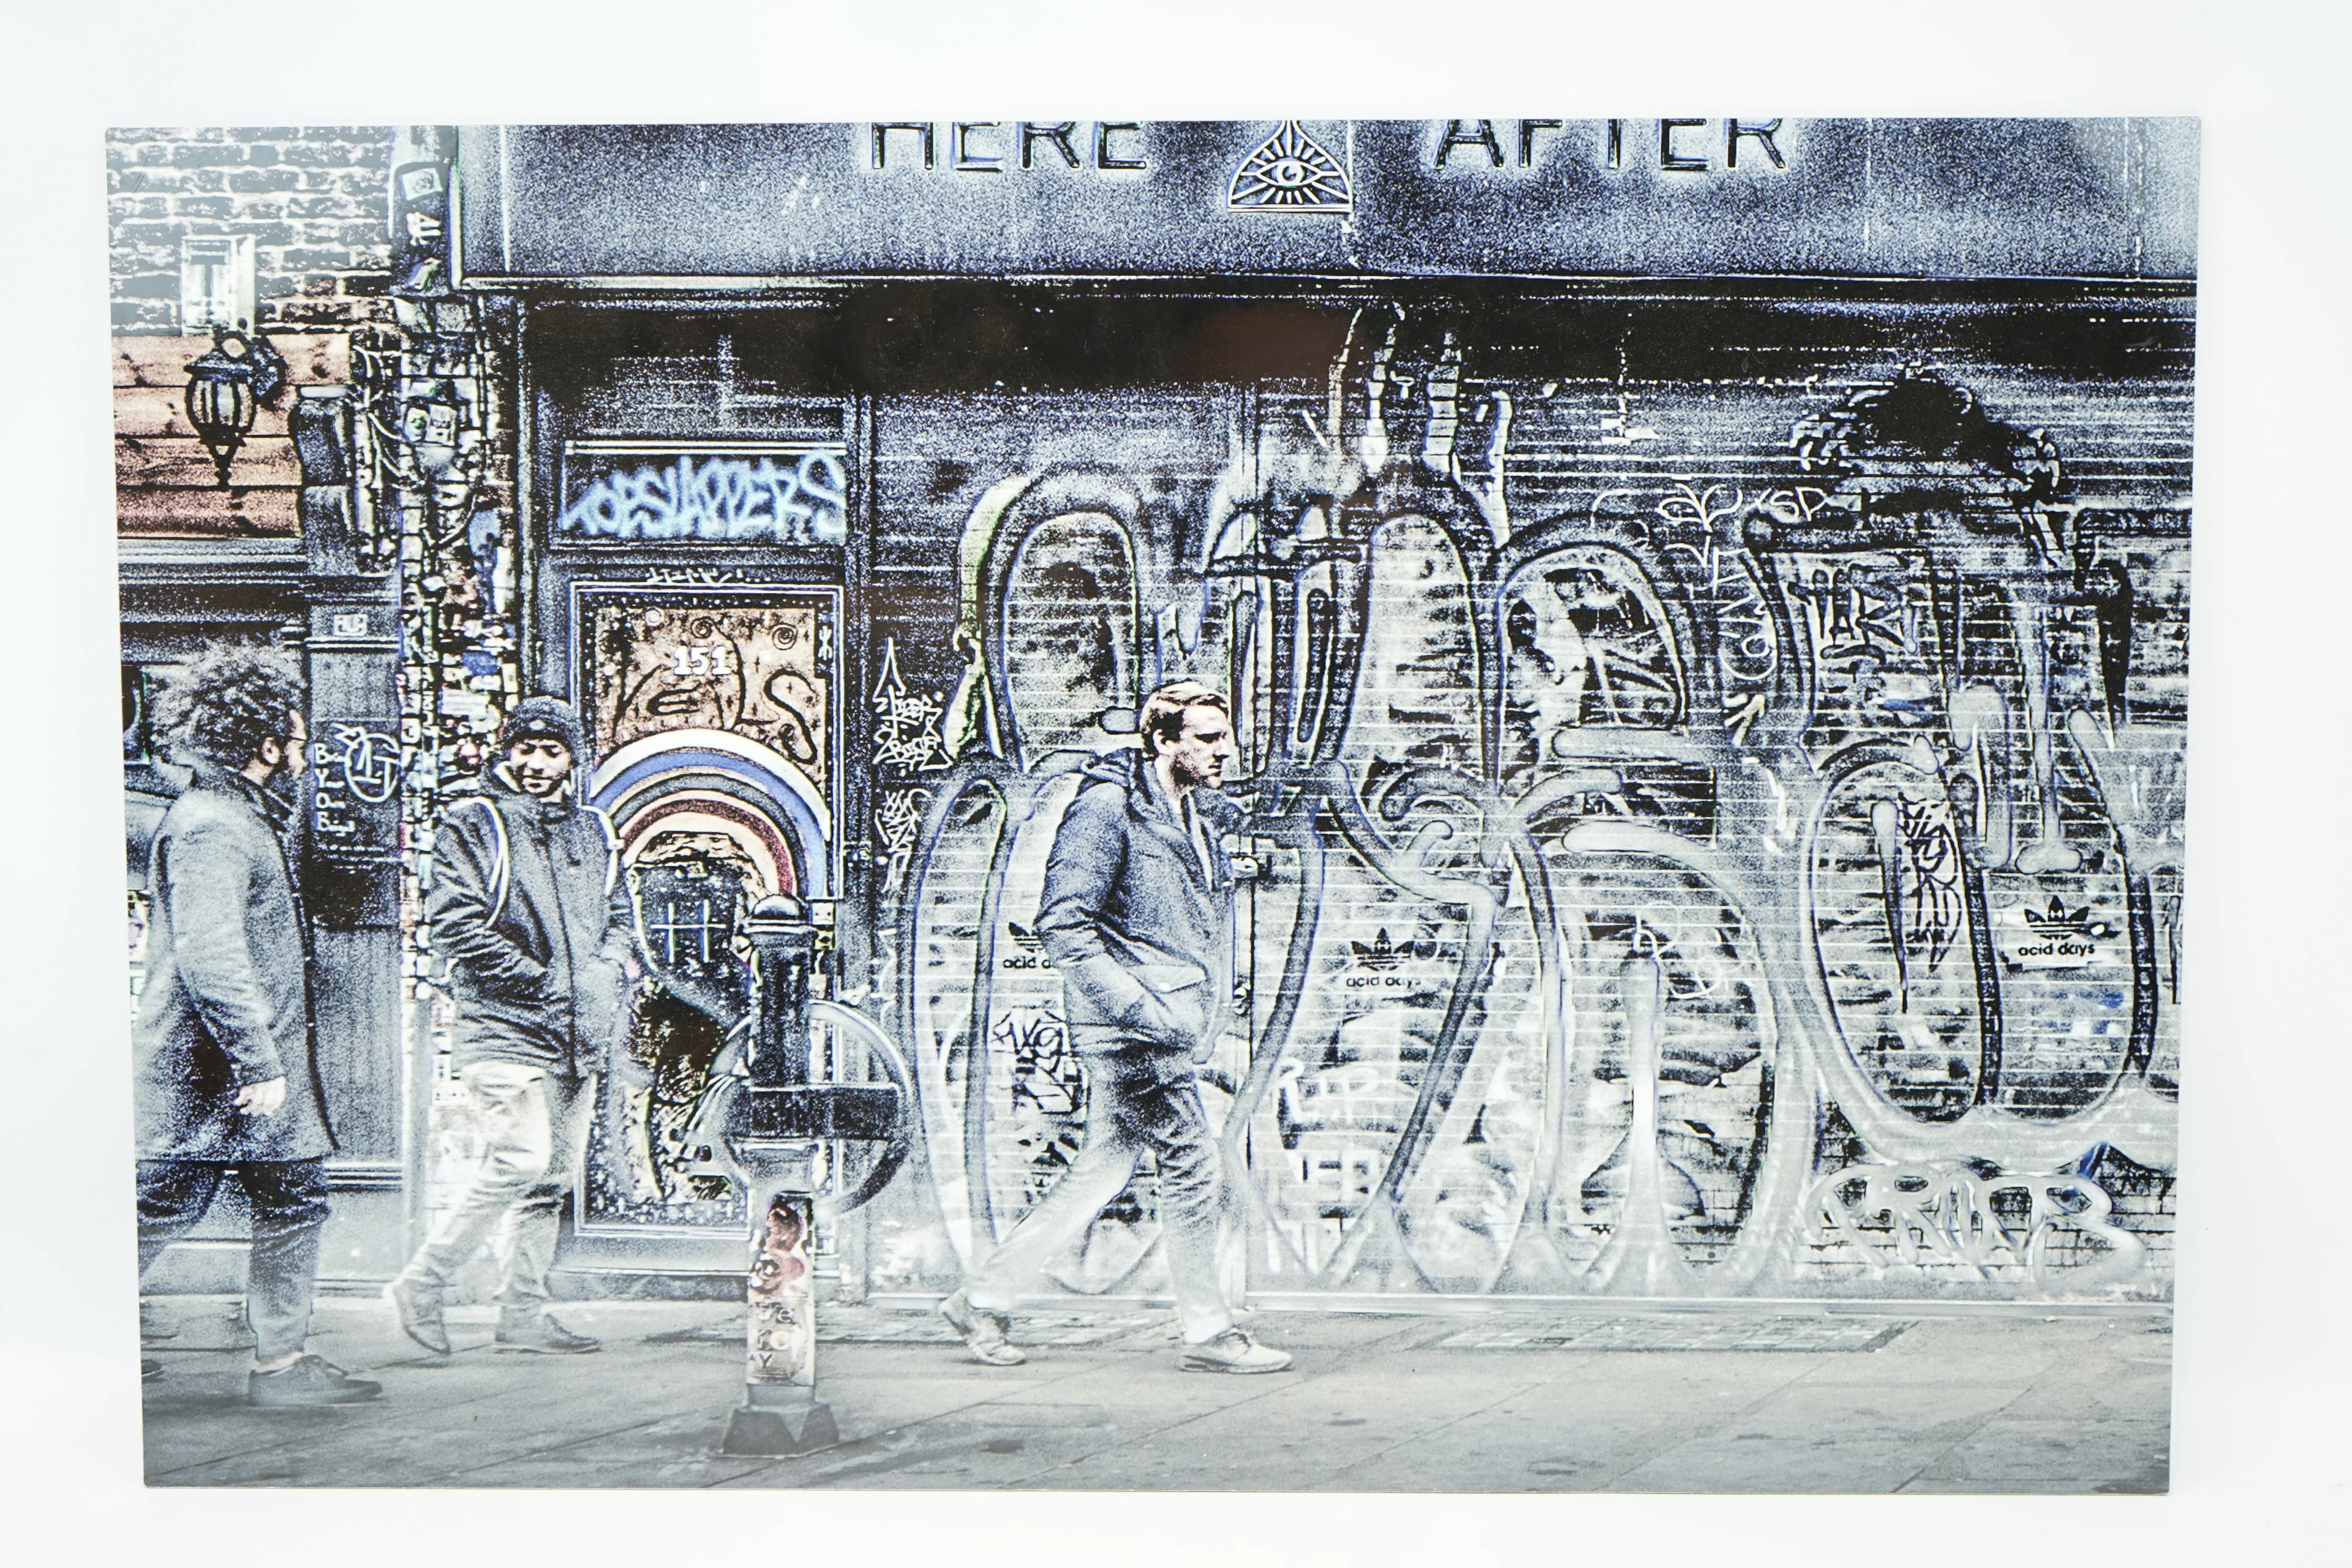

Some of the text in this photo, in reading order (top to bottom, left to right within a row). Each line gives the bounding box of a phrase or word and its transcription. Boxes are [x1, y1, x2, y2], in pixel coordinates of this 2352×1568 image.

[674, 645, 731, 675] 151
[2018, 942, 2095, 957] acid days
[1003, 956, 1036, 968] acid
[1346, 976, 1379, 987] acid
